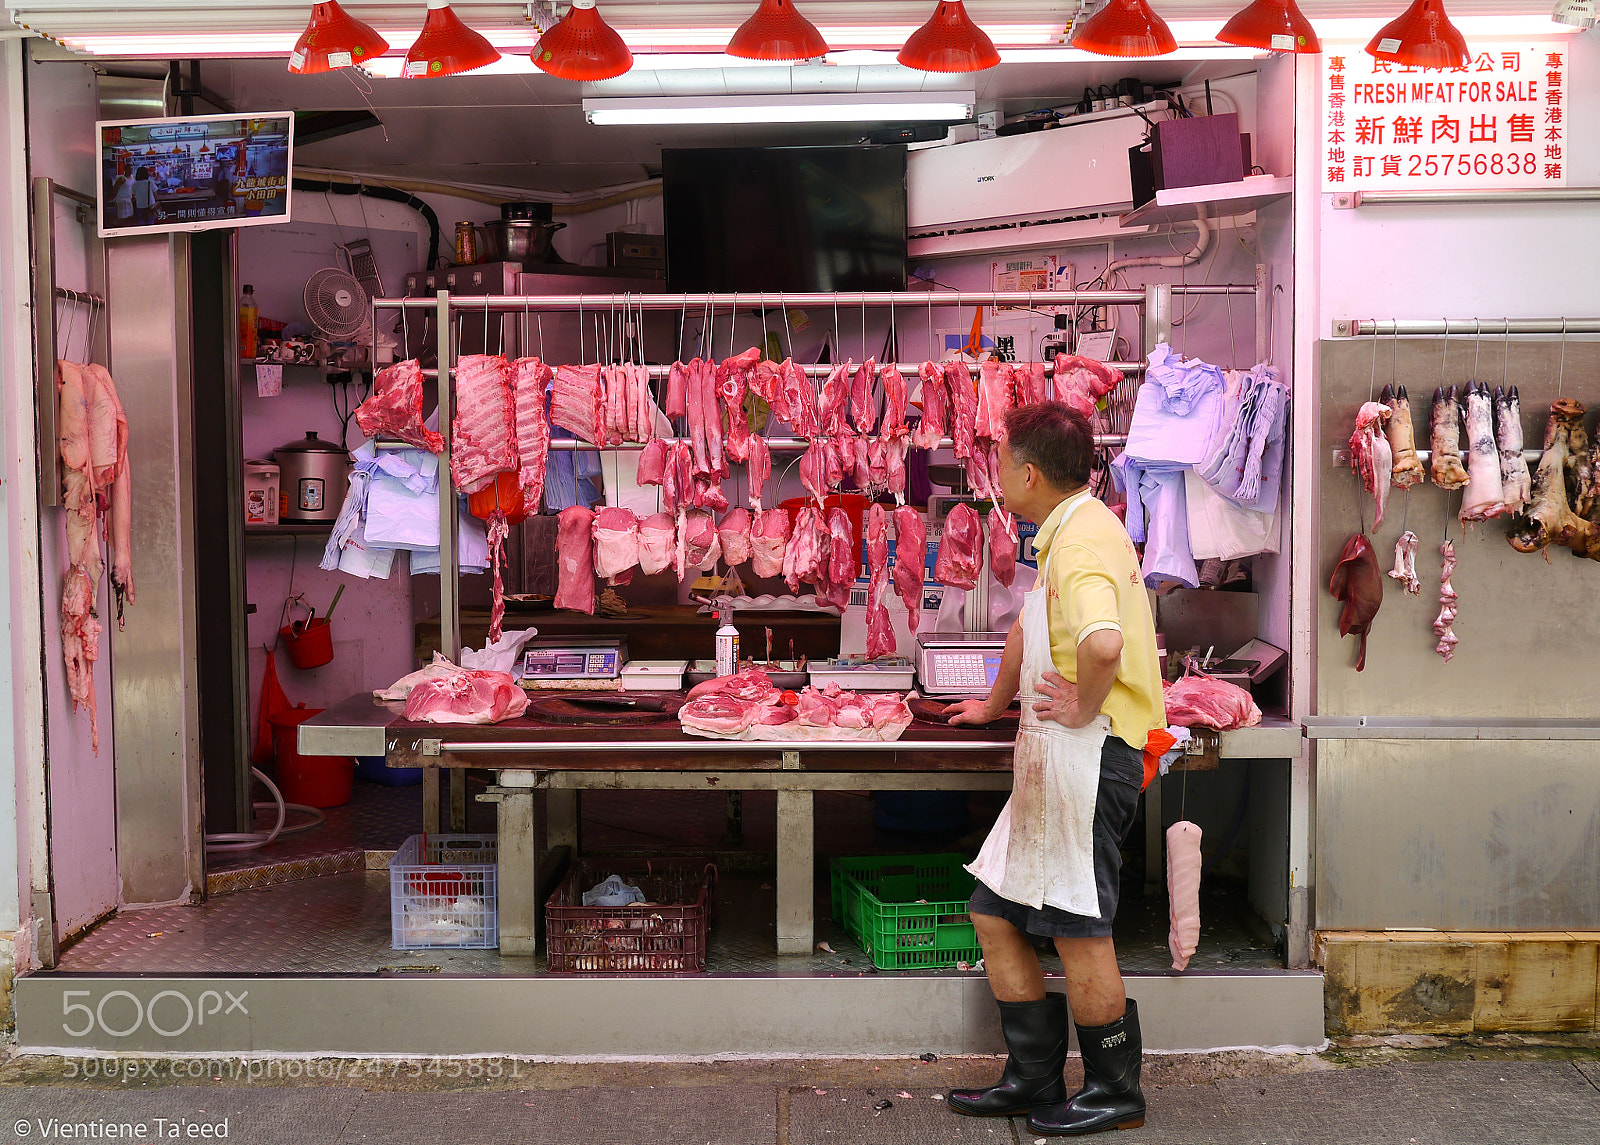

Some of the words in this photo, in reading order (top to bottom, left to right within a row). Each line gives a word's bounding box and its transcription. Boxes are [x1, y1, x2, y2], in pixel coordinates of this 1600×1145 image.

[1354, 83, 1406, 104] FRESH
[1411, 82, 1454, 104] MEAT
[1458, 81, 1492, 103] FOR
[1496, 80, 1538, 102] SALE
[1327, 55, 1346, 183] 專售香港本地豬
[1355, 113, 1536, 146] 新鮮肉出售
[1544, 52, 1563, 180] 專售香港本地豬
[1407, 152, 1537, 177] 25756838
